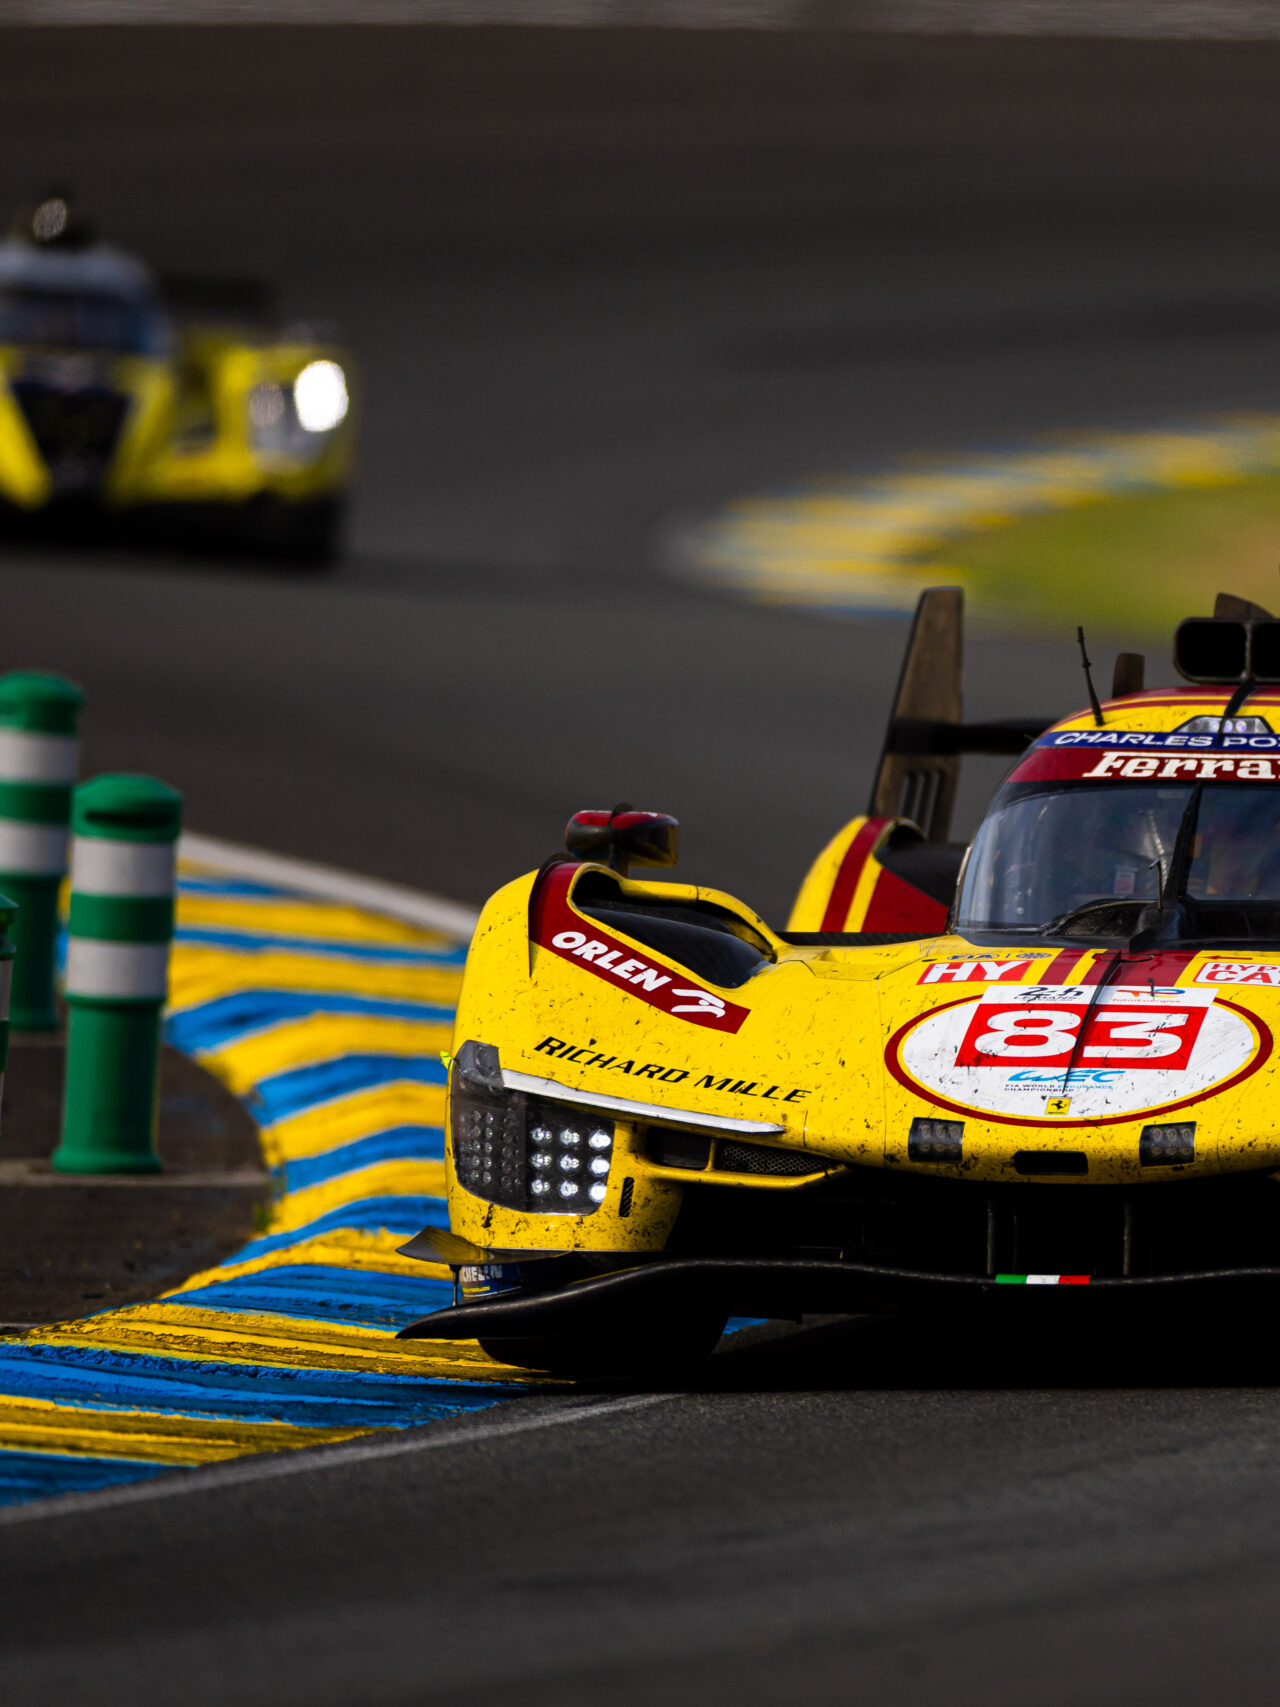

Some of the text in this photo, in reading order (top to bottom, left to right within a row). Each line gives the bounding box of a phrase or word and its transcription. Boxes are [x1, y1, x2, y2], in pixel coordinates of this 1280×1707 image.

[1054, 731, 1213, 748] CHARLES
[551, 930, 672, 993] ORLEN
[923, 960, 1026, 983] HY
[974, 1009, 1190, 1060] 83
[534, 1035, 812, 1104] RICHARD MILLE
